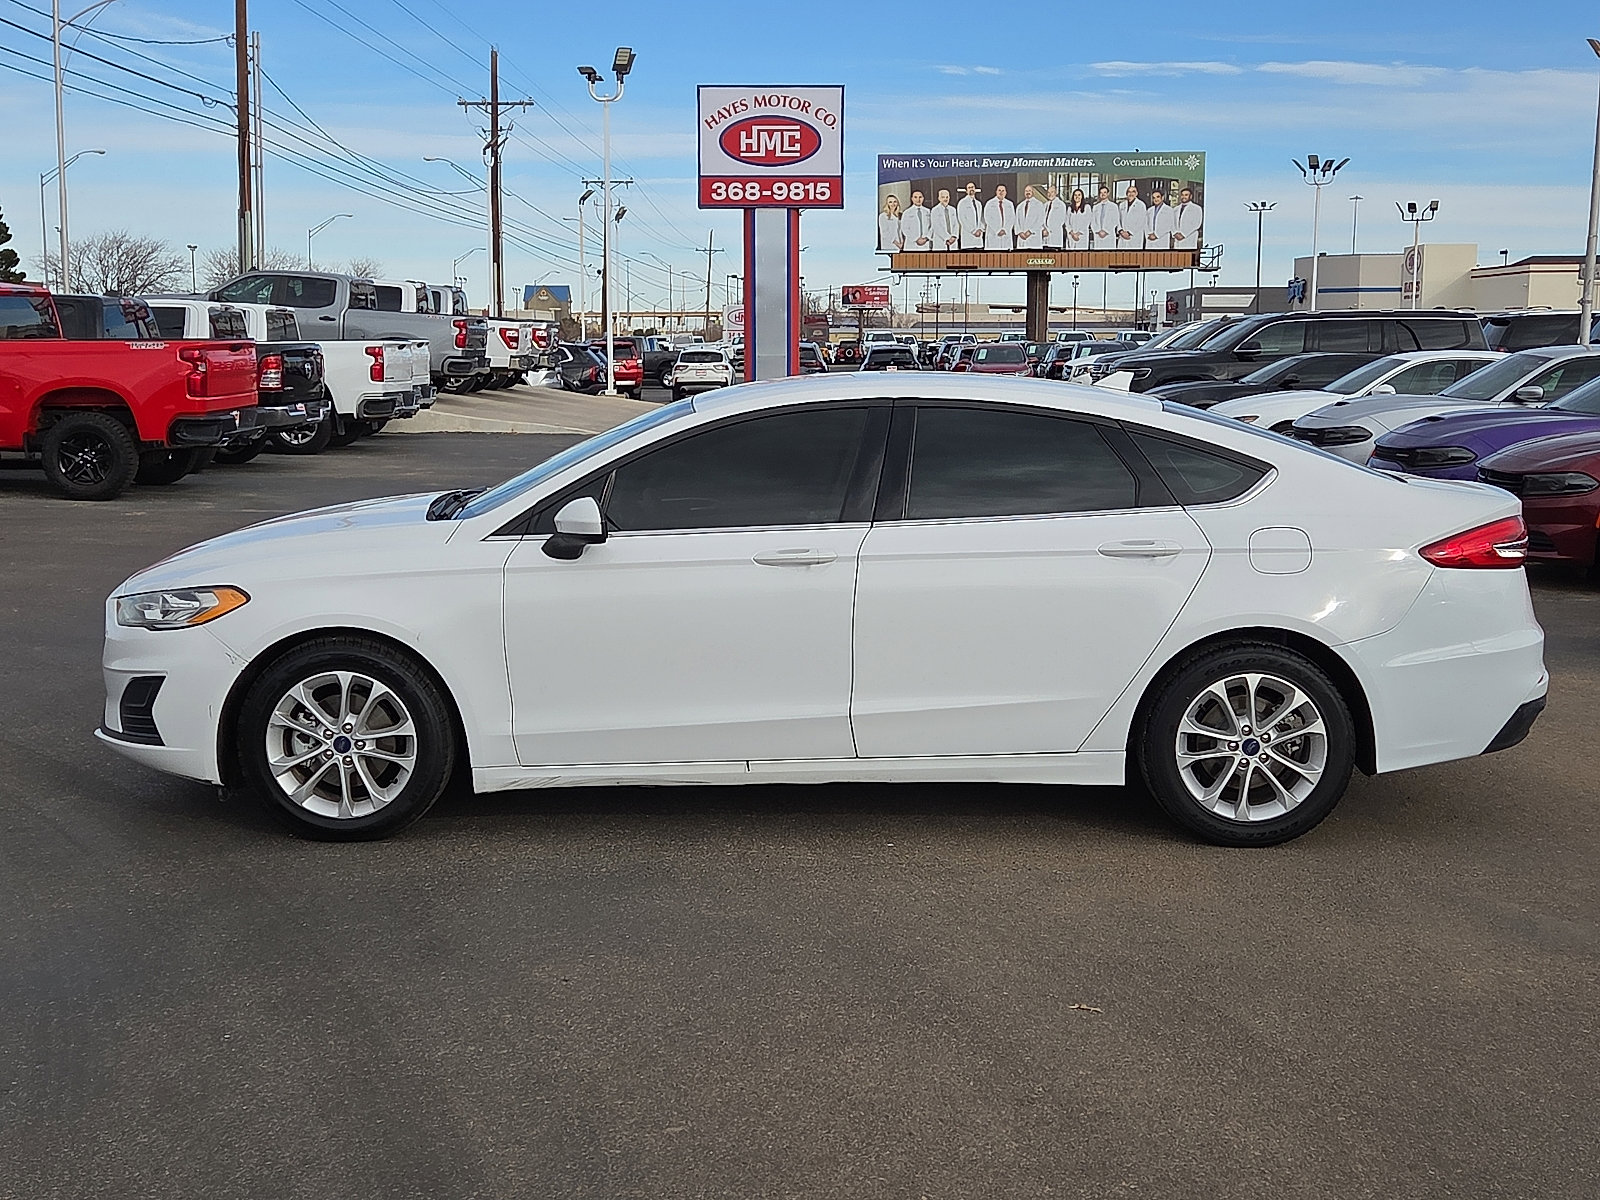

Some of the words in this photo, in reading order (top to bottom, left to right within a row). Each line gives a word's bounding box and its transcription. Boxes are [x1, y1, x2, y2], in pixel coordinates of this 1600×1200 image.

[704, 98, 749, 130] HAYES
[753, 94, 812, 114] MOTOR
[814, 107, 837, 130] CO.
[740, 125, 801, 157] HMC
[882, 158, 910, 168] When
[911, 158, 926, 168] It's
[927, 158, 949, 168] Your
[951, 158, 981, 169] Heart,
[981, 158, 1012, 169] Every
[1012, 157, 1054, 168] Moment
[1054, 157, 1096, 167] Matters.
[711, 181, 831, 201] 368-9815
